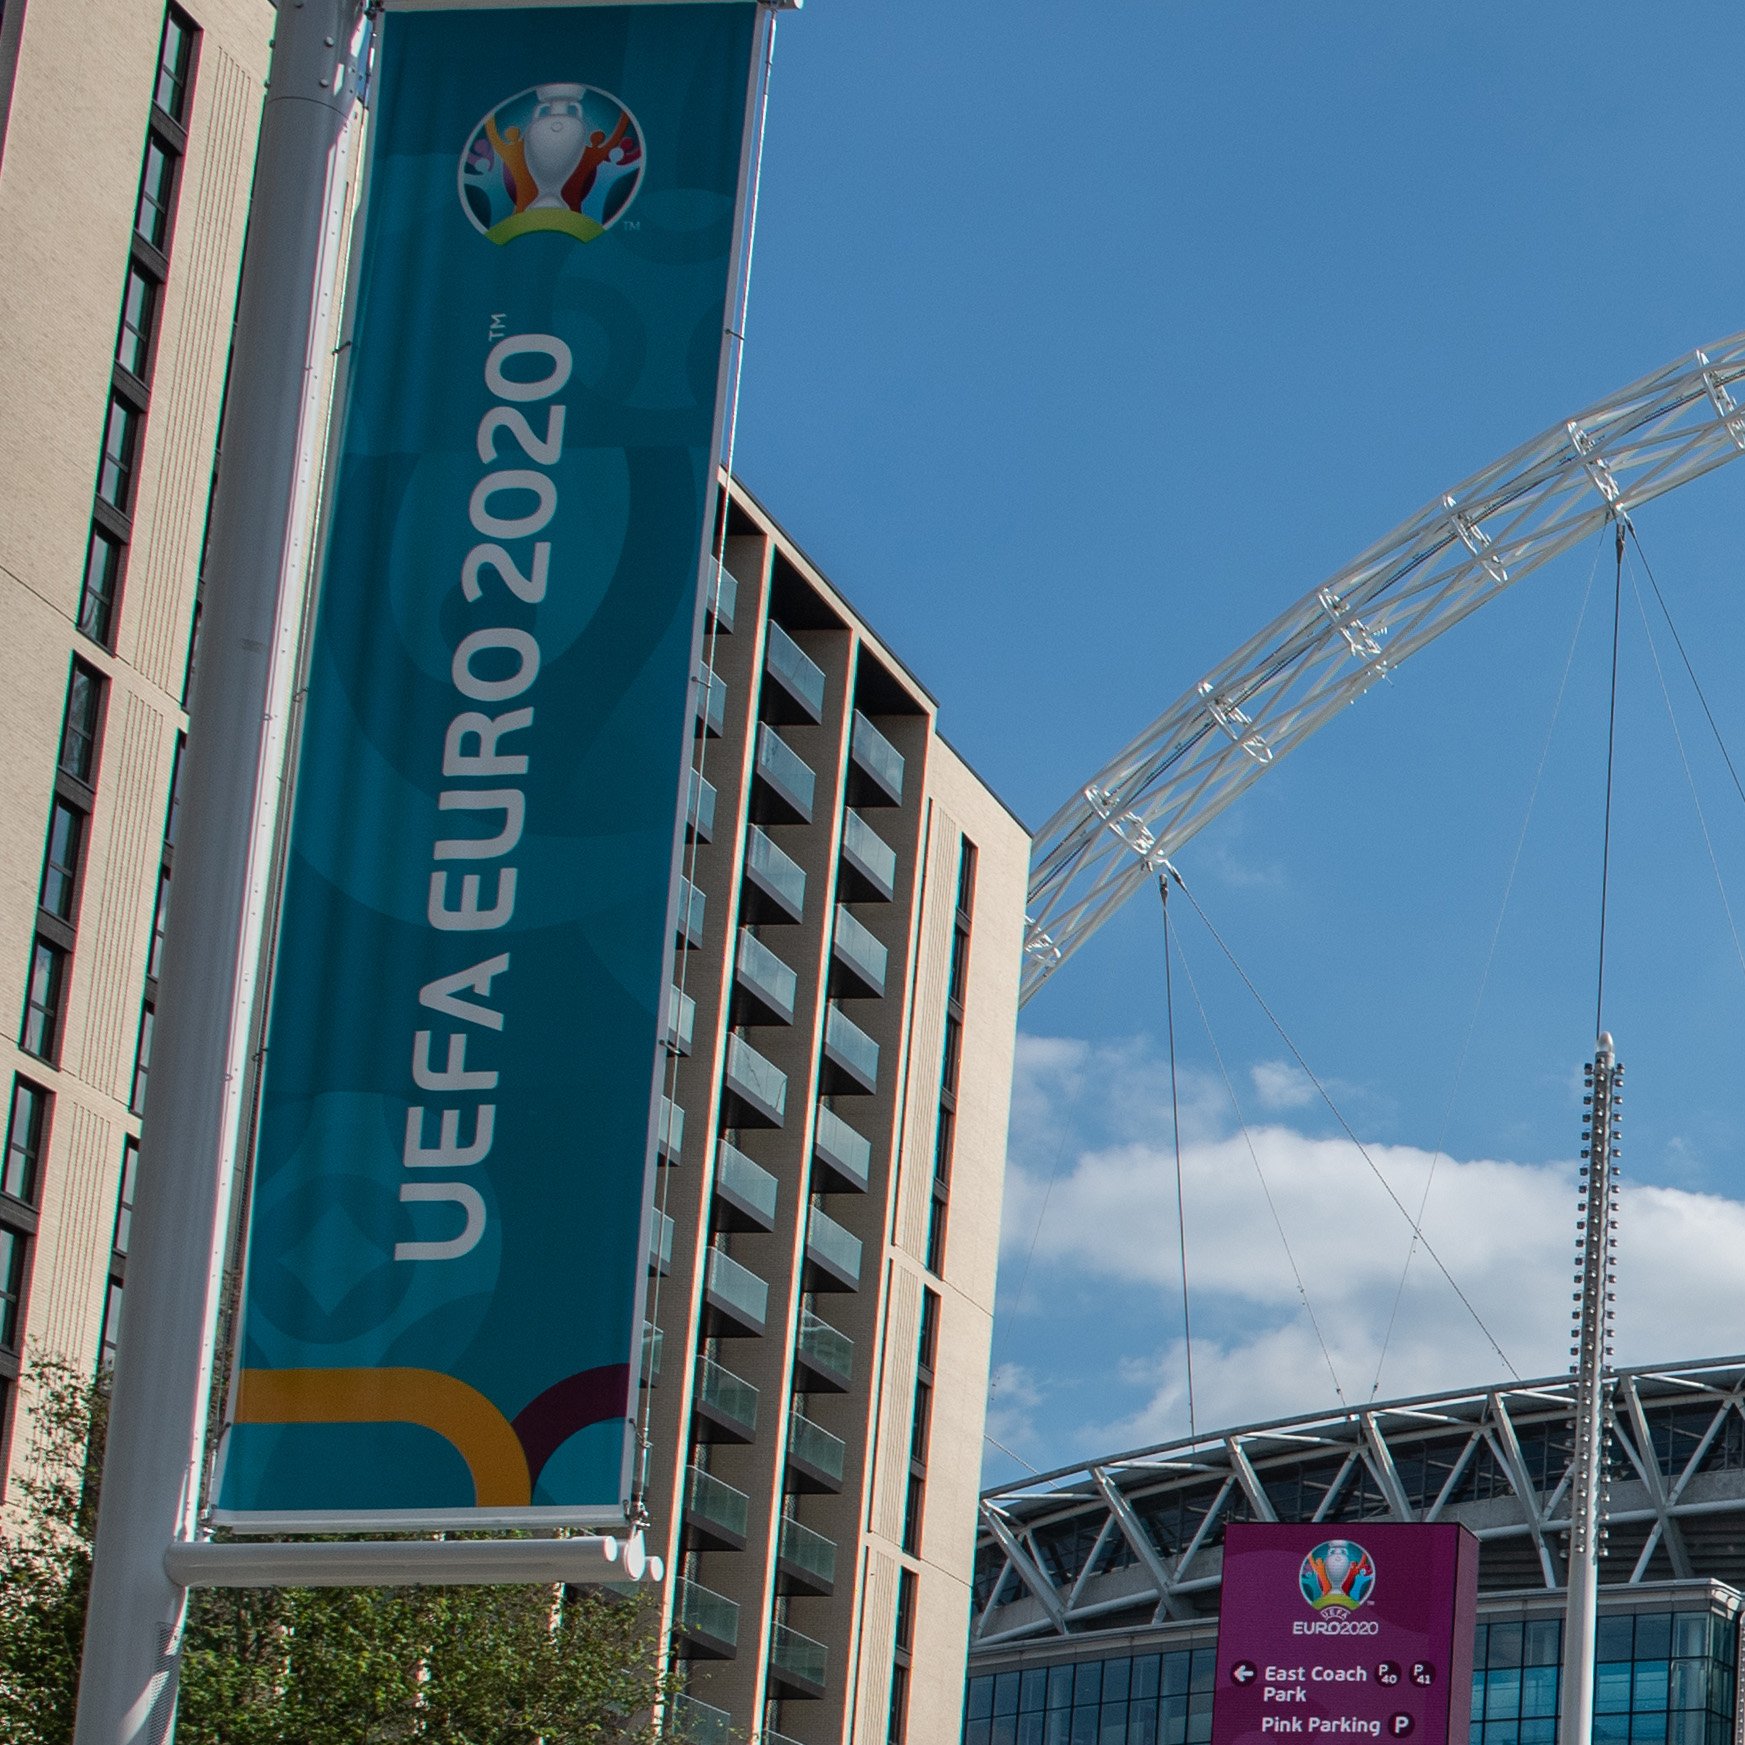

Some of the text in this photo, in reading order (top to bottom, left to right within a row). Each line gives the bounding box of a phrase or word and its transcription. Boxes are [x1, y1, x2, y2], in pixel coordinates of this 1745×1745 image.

[461, 333, 572, 603] 2020
[427, 628, 540, 930] EURO
[394, 953, 508, 1260] UEFA
[1321, 1607, 1349, 1620] UEFA
[1293, 1621, 1378, 1635] EURO2020
[1266, 1666, 1305, 1681] East
[1312, 1666, 1366, 1681] Coach
[1264, 1686, 1306, 1701] Park
[1262, 1717, 1408, 1736] Pink Parking P
